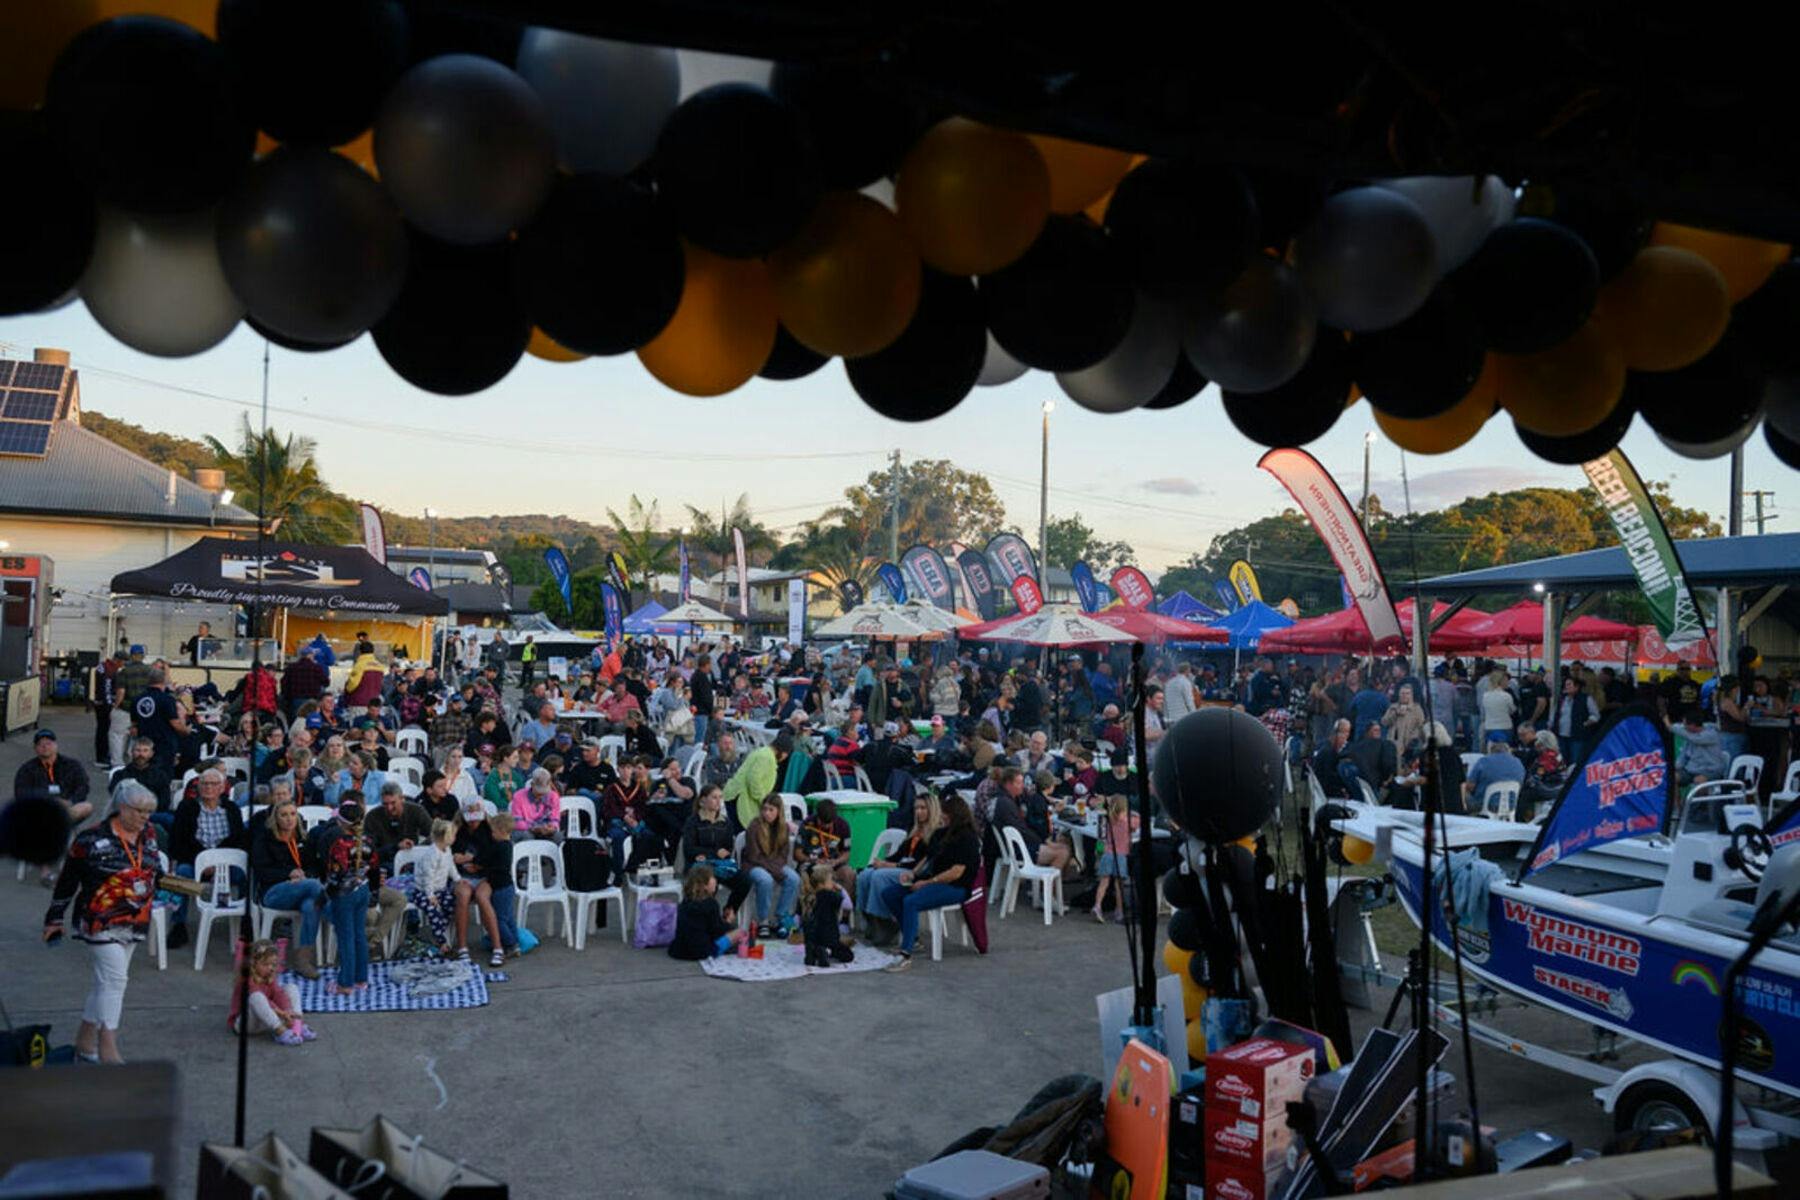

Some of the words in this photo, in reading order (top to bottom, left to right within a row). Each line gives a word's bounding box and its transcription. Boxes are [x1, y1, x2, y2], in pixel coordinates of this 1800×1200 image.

[1584, 456, 1632, 509] REEN
[170, 583, 233, 604] Proudly
[327, 595, 400, 613] Community
[1502, 898, 1642, 958] Wynnum
[1528, 926, 1640, 976] Marine
[1533, 966, 1611, 1004] STACER
